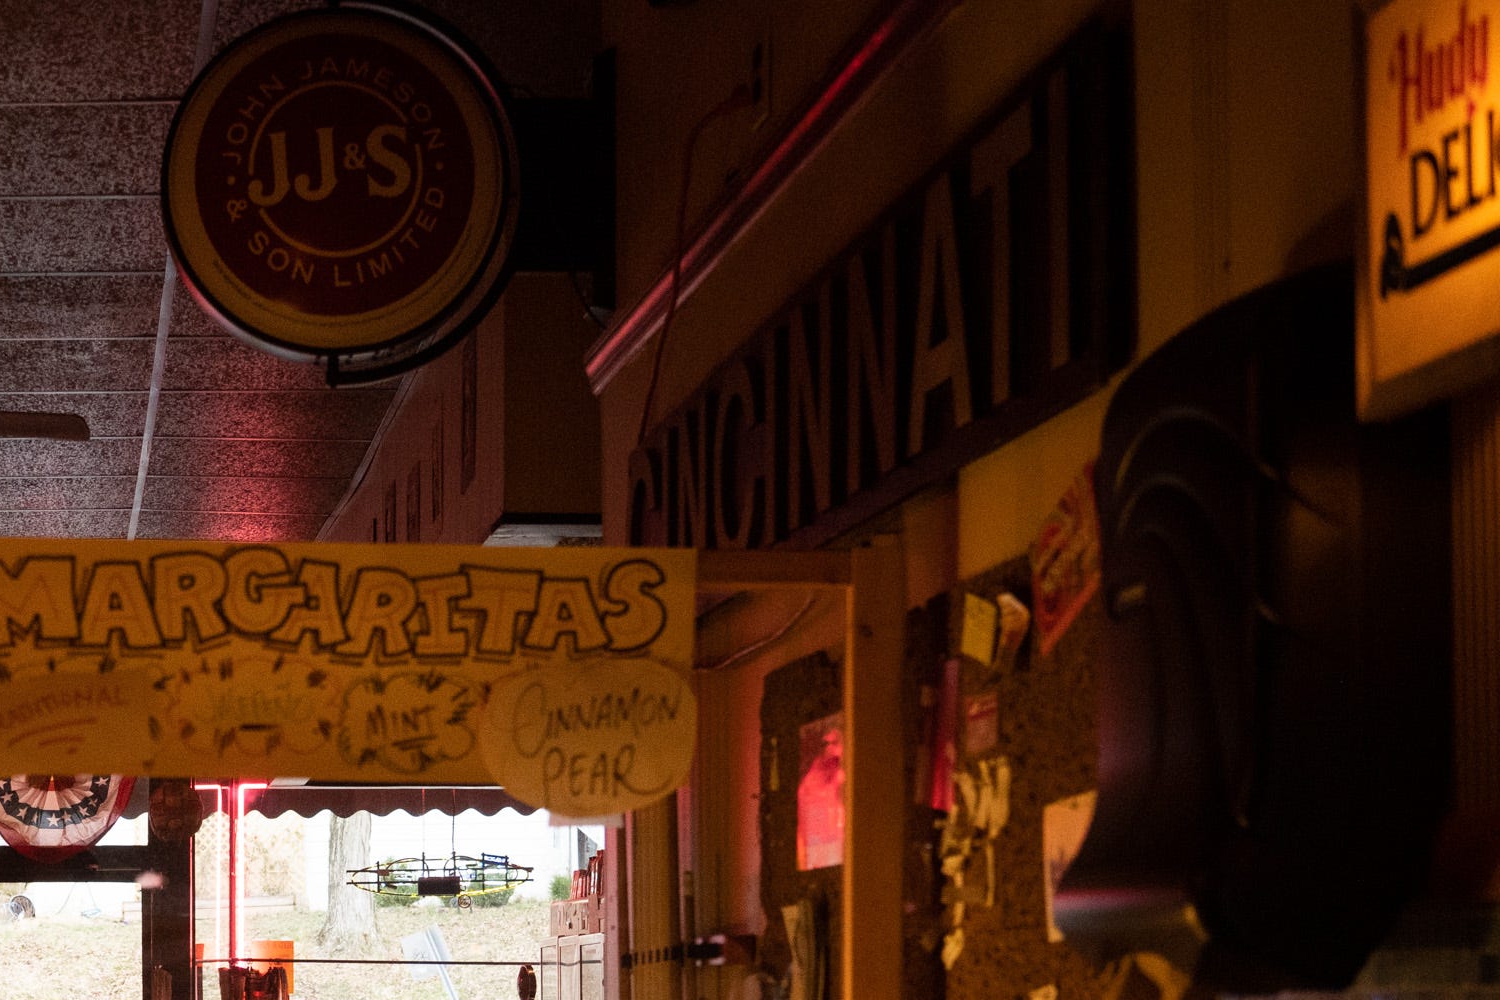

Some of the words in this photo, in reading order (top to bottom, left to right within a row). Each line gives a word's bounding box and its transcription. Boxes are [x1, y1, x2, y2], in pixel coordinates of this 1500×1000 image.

[222, 72, 288, 165] JOHN
[300, 56, 446, 151] JAMESON
[1410, 110, 1500, 241] DELI
[227, 199, 249, 222] &
[249, 230, 316, 285] SON
[333, 186, 446, 288] LIMITED
[543, 743, 674, 808] PEAR
